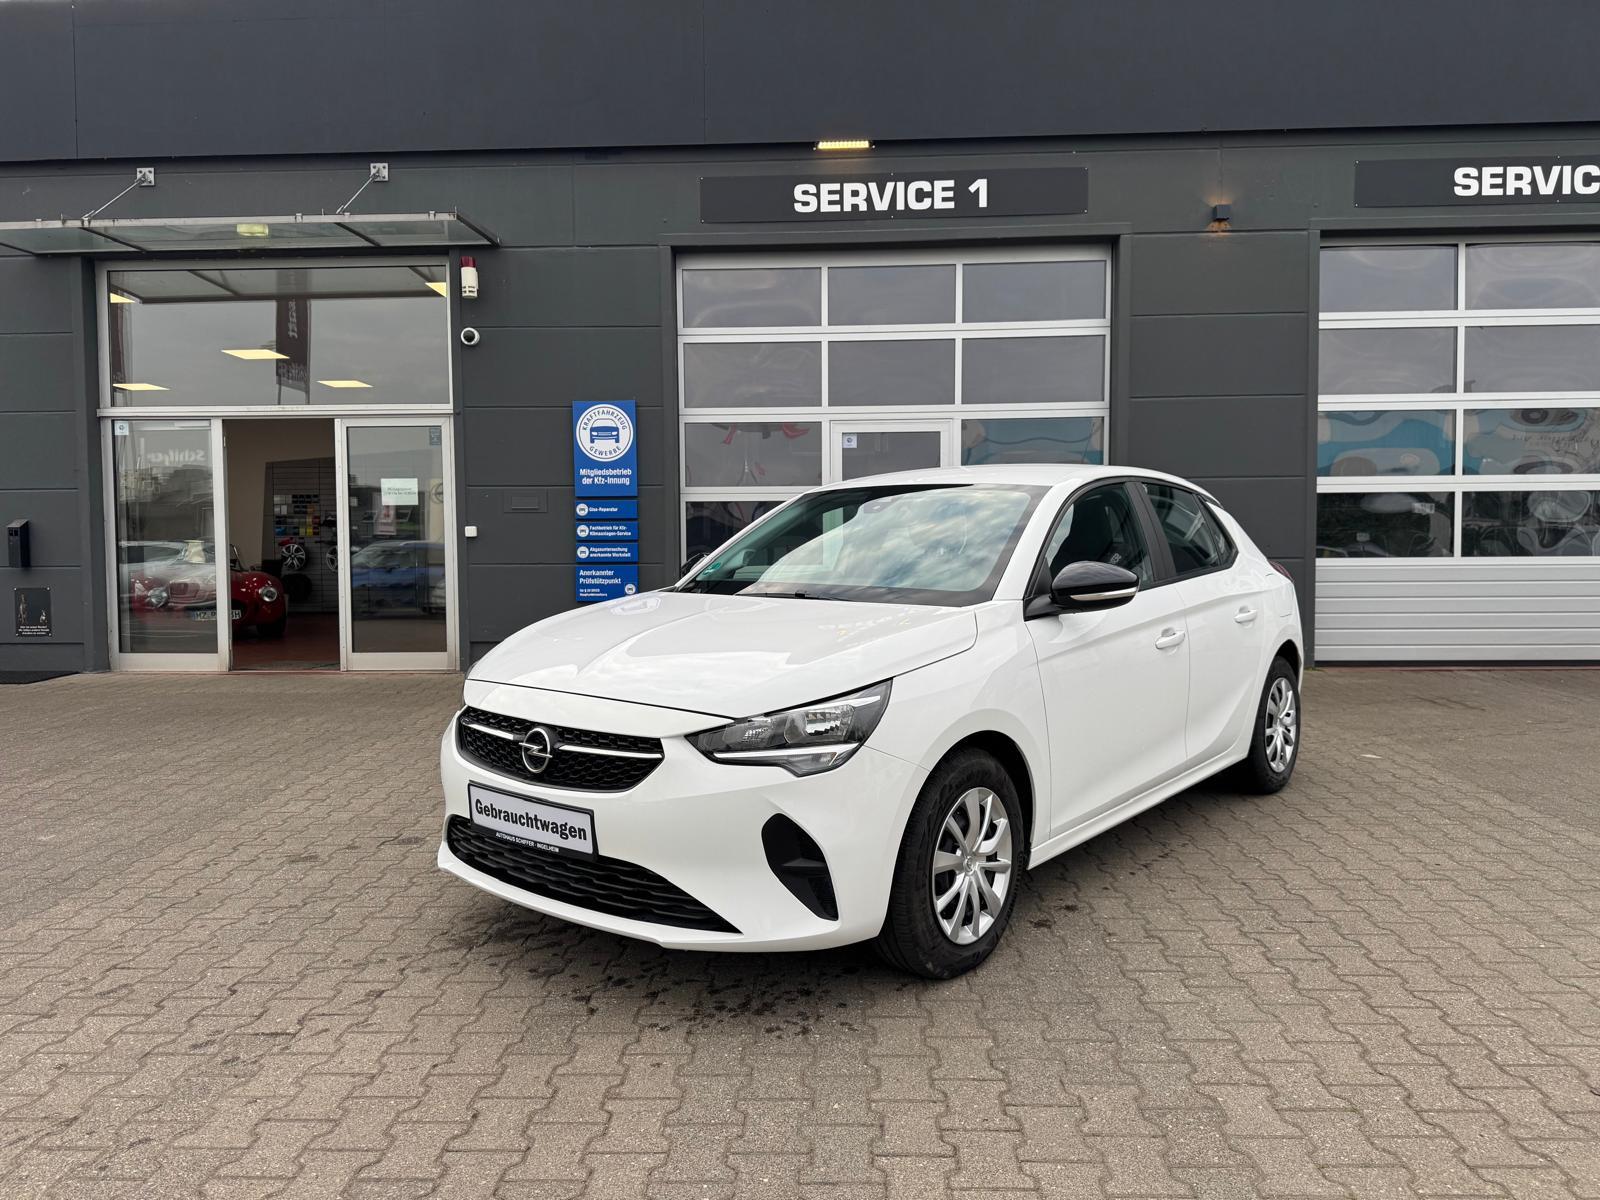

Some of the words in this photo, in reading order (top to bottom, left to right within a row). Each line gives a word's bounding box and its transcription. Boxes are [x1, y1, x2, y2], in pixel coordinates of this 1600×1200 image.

[1454, 165, 1600, 197] SERVIC
[793, 180, 955, 213] SERVICE
[968, 179, 988, 208] 1
[582, 409, 628, 431] KRAFTFAHRZEUG
[589, 445, 622, 456] GEWERBE
[580, 468, 632, 477] Mitgliedsbetrieb
[582, 477, 593, 485] der
[594, 477, 630, 486] Kfz-Innung
[579, 577, 622, 585] Prüfstützpunkt
[475, 798, 587, 841] Gebrauchtwagen
[495, 831, 516, 842] AUTOHAUS
[515, 837, 535, 848] SCHIFFER
[536, 842, 560, 853] INGELHEIM
